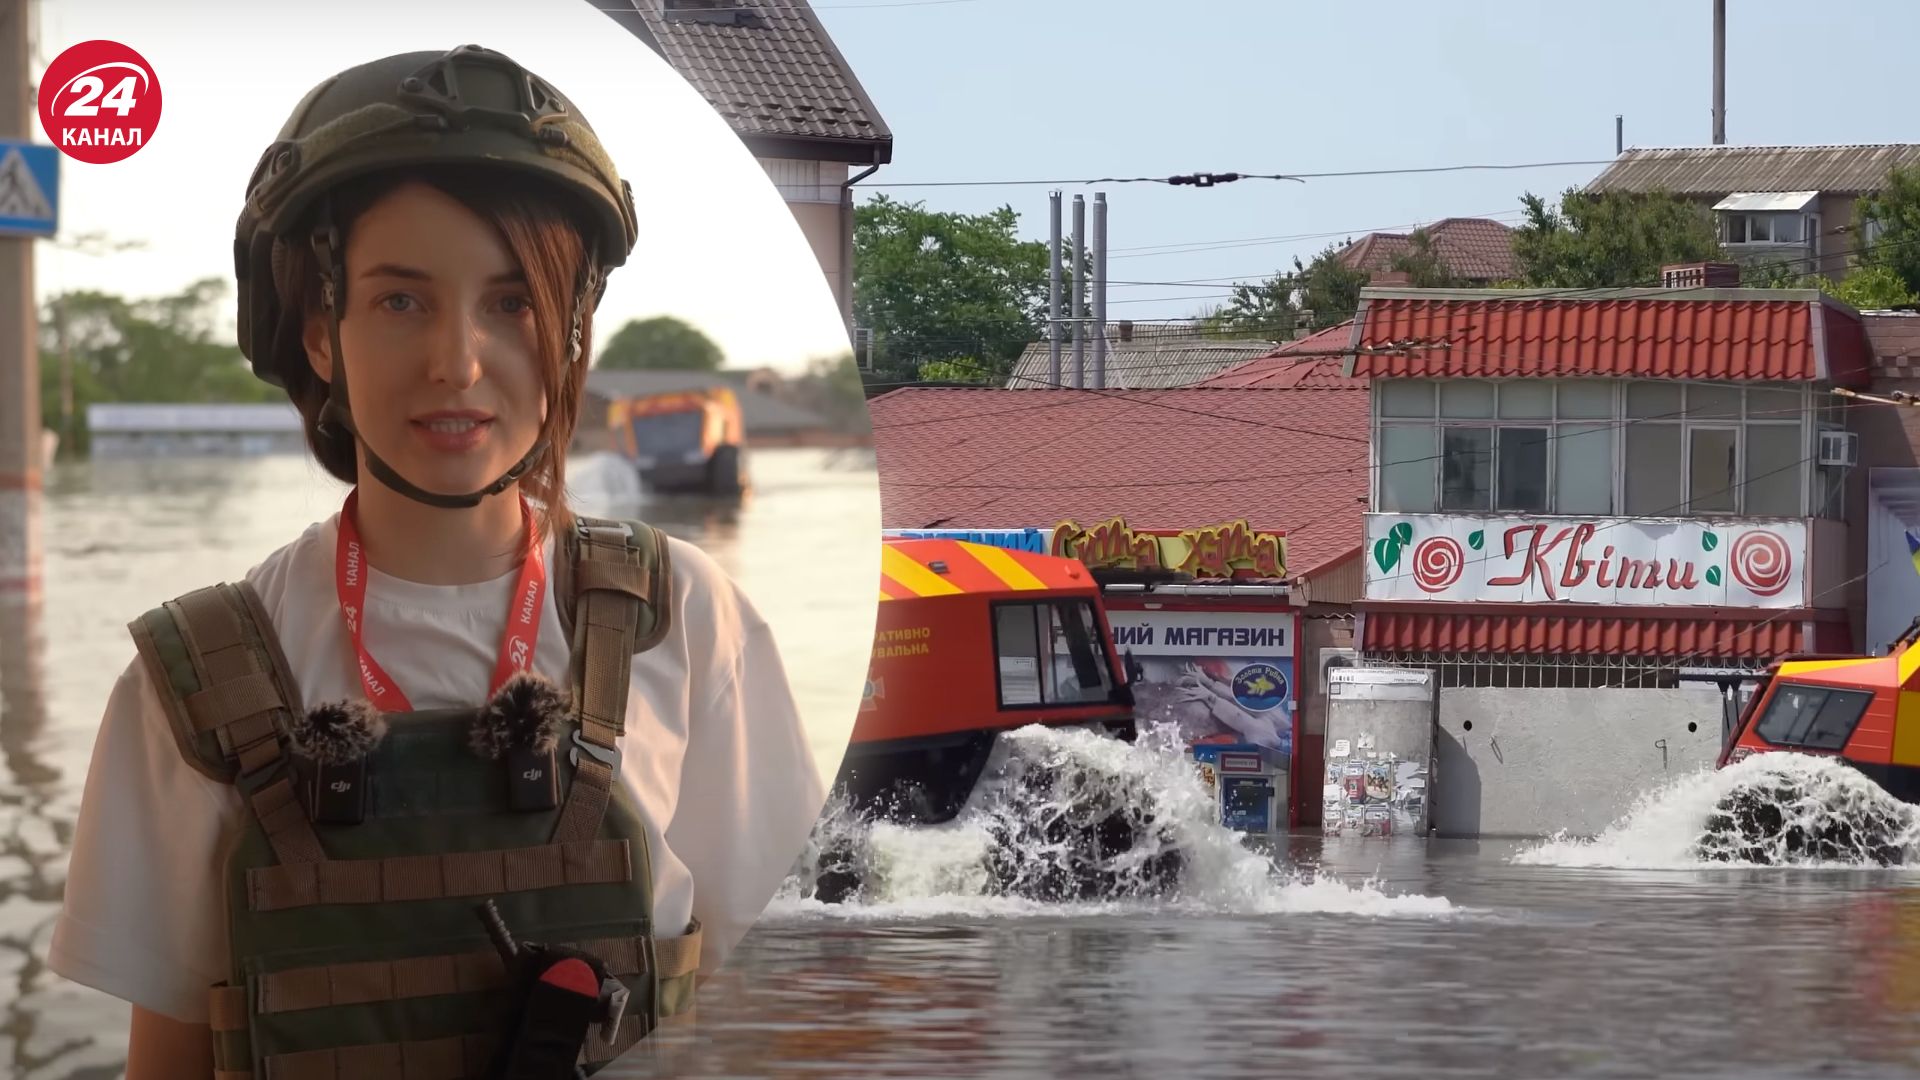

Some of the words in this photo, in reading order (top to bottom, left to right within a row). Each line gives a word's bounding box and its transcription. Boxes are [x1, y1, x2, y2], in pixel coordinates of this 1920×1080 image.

[346, 542, 360, 586] КАНАЛ
[1486, 523, 1699, 600] Квіти
[345, 605, 357, 633] 24
[512, 638, 528, 668] 24
[520, 580, 538, 624] КАНАЛ
[1164, 627, 1284, 647] МАГАЗИН
